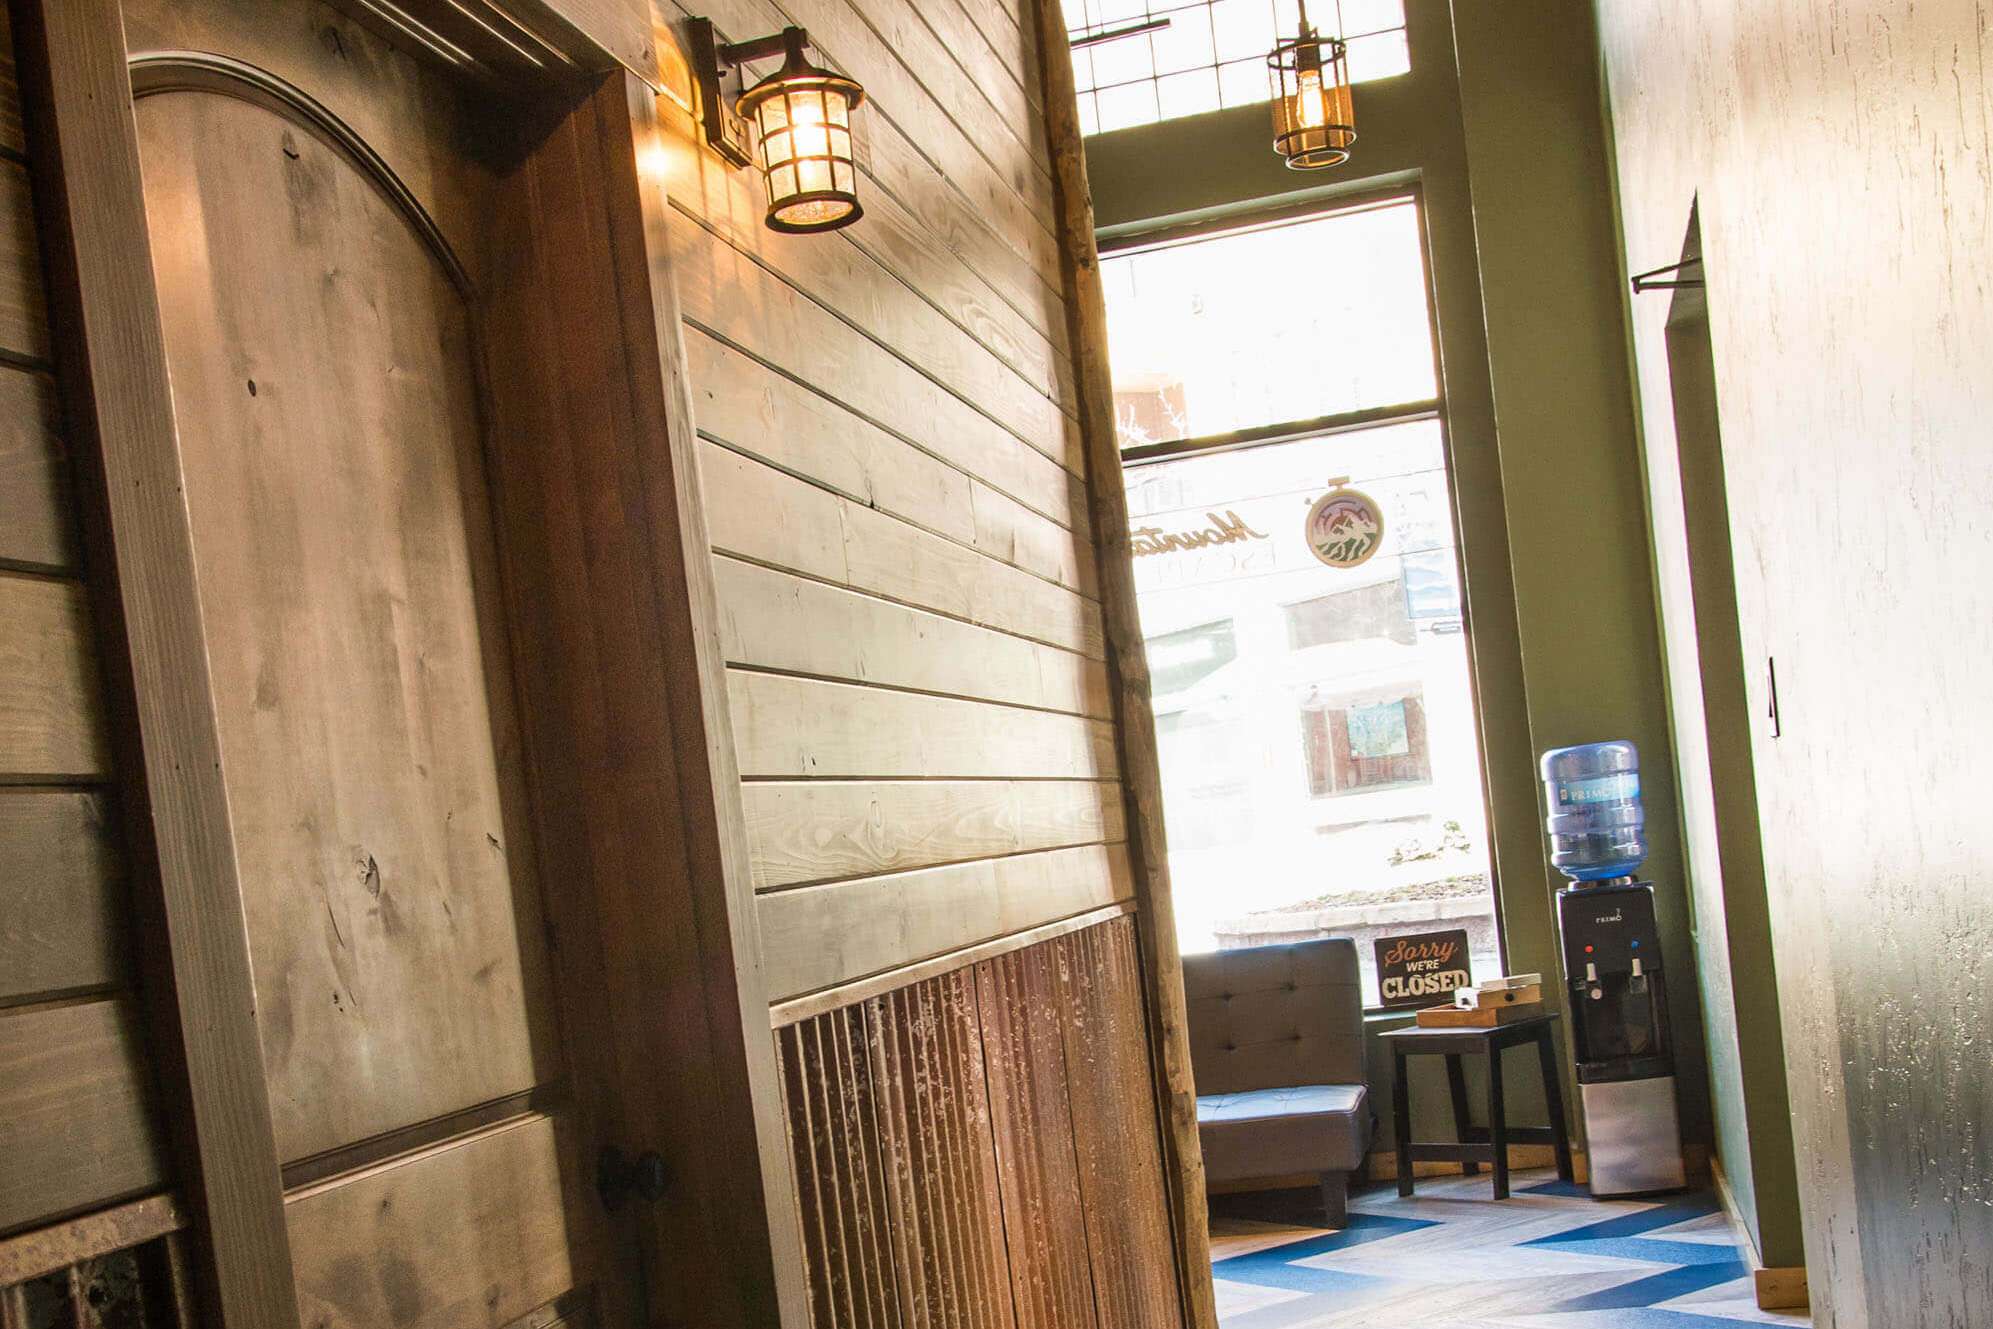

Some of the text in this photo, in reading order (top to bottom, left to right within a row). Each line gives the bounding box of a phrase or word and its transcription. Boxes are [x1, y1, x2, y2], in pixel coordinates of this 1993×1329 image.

[1384, 939, 1459, 967] Sorry
[1406, 959, 1440, 973] WE'RE
[1382, 969, 1469, 999] CLOSED
